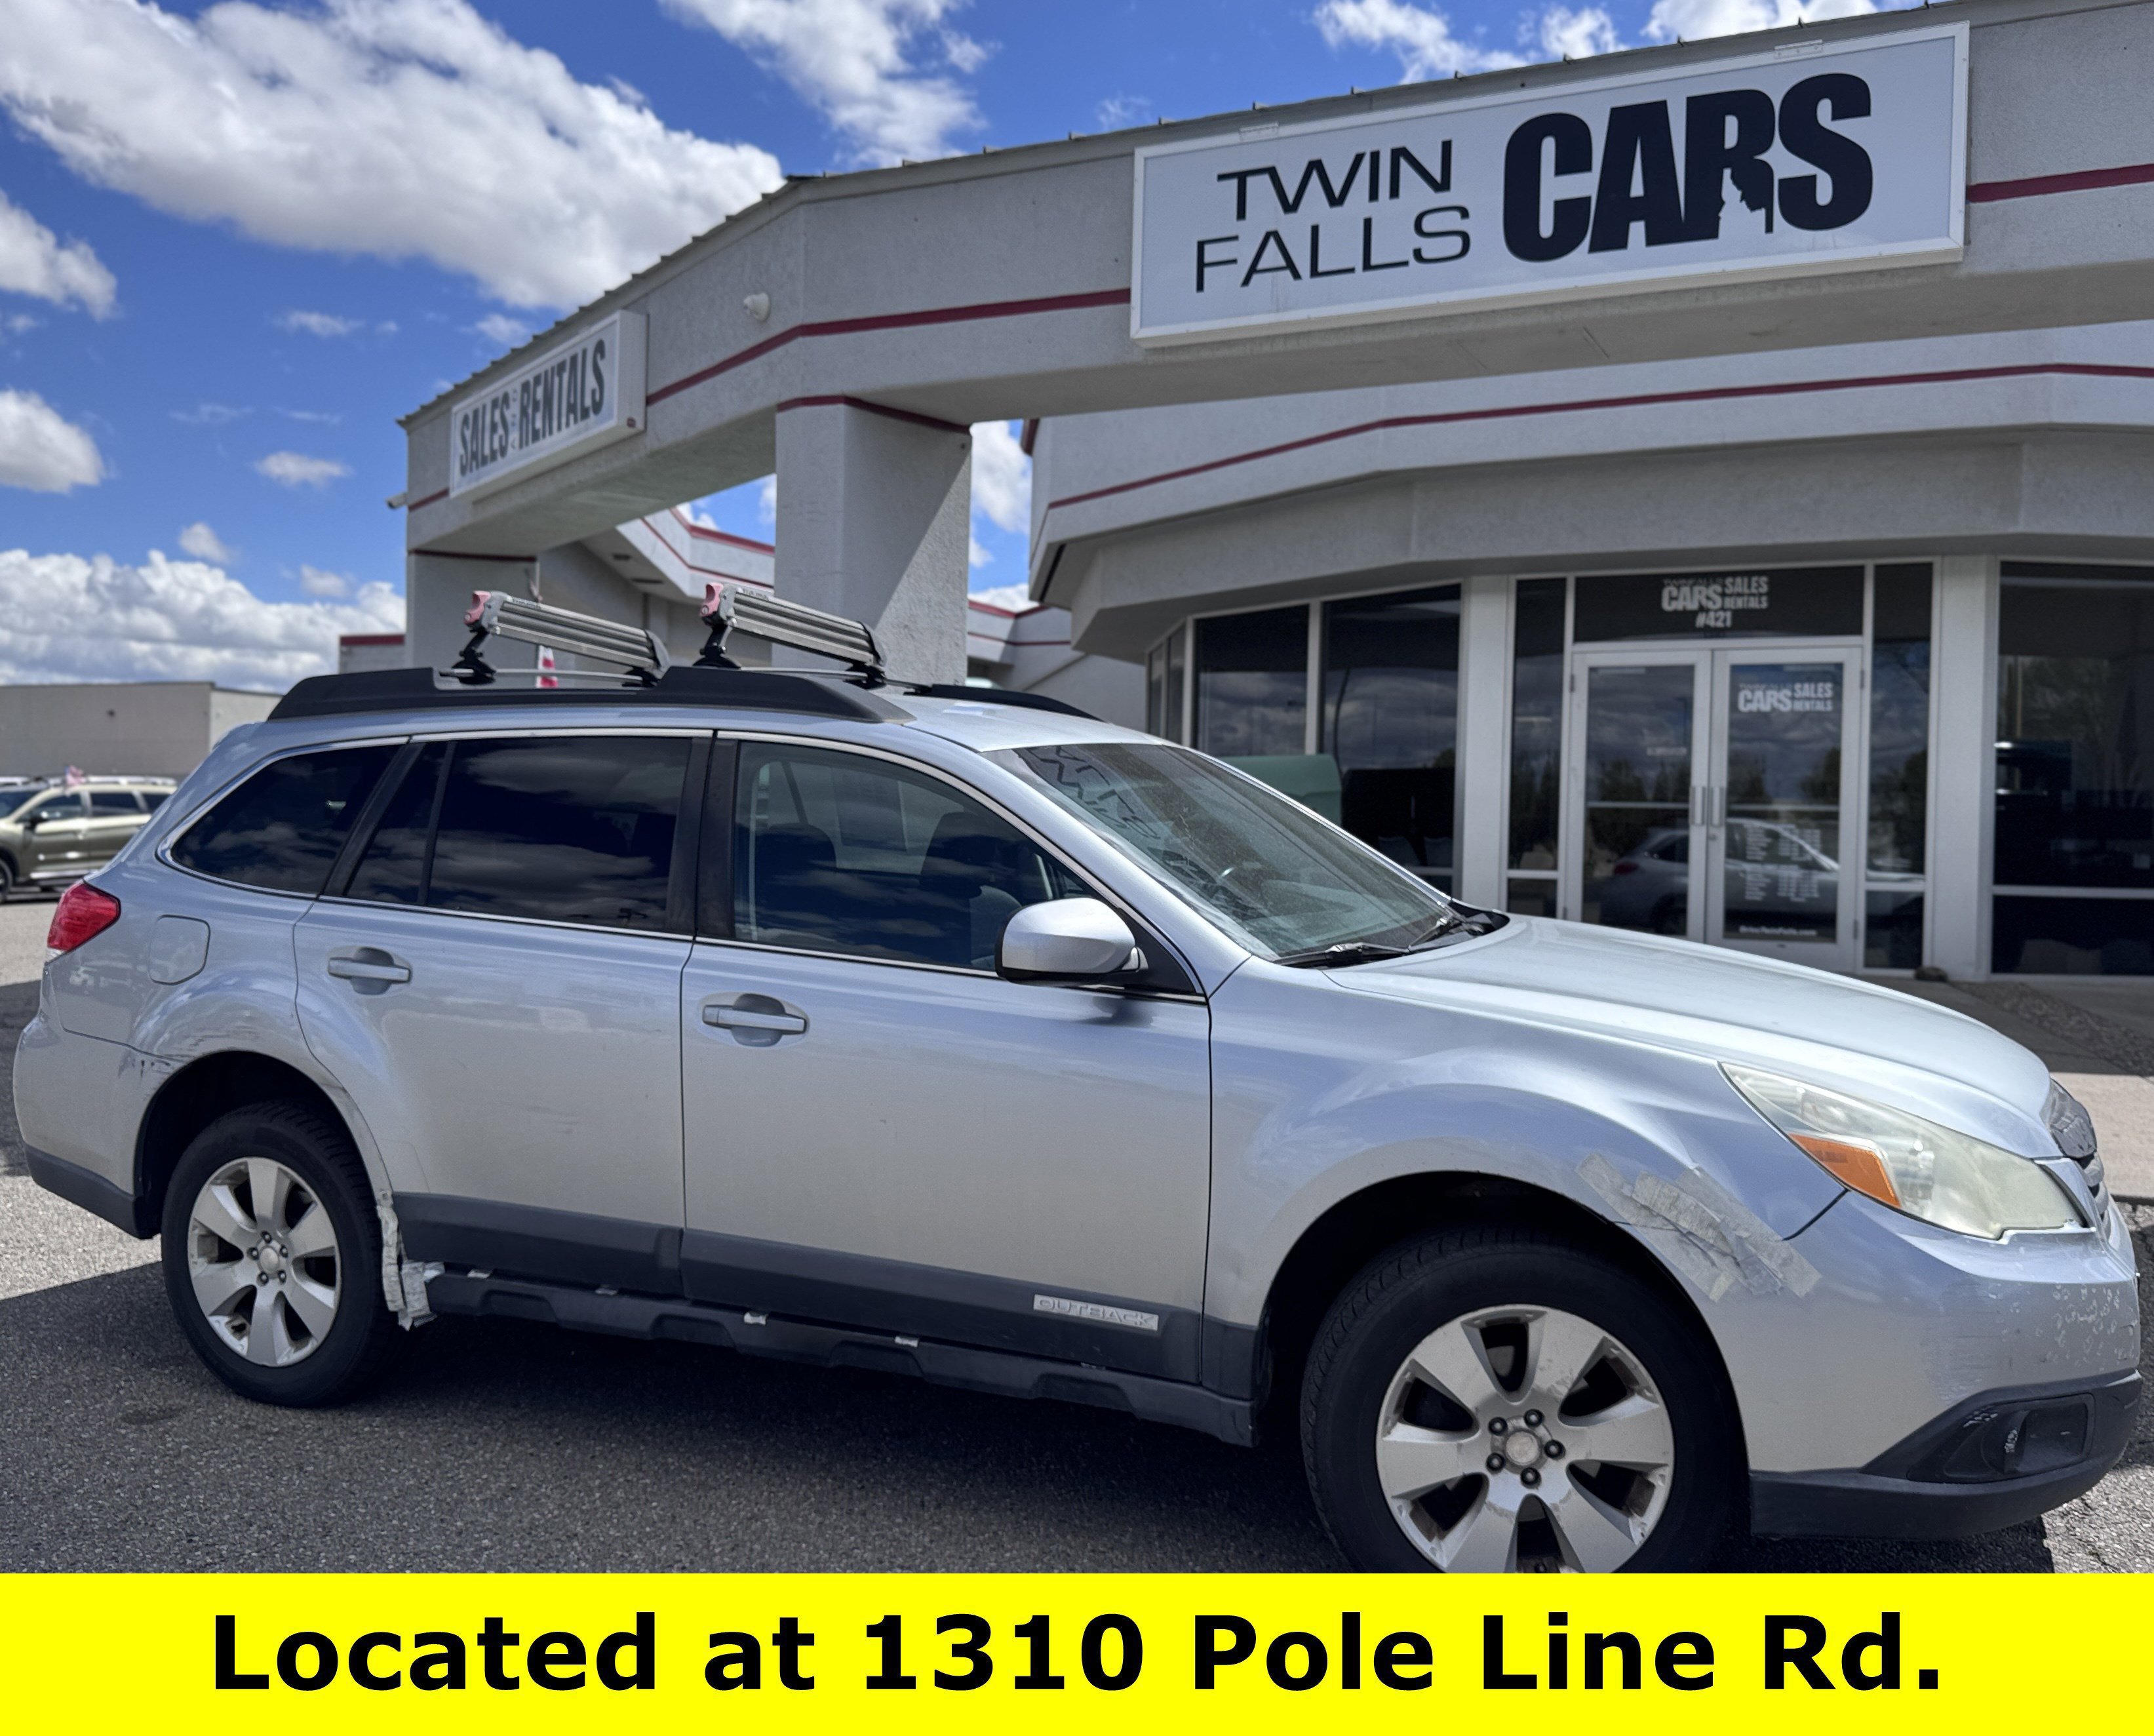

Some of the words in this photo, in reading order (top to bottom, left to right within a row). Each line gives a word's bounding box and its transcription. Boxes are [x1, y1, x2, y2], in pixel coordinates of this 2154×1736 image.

[1217, 140, 1452, 221] TWIN
[1502, 72, 1873, 262] CARS
[1196, 205, 1471, 292] FALLS
[460, 391, 510, 477] SALES
[519, 339, 606, 450] RENTALS
[1662, 584, 1723, 611] CARS
[1725, 576, 1769, 594] SALES
[1723, 595, 1768, 609] RENTALS
[1695, 610, 1732, 628] #421
[1738, 689, 1793, 713] CARS
[1793, 682, 1833, 698] SALES
[1039, 1299, 1154, 1329] OUTBACK
